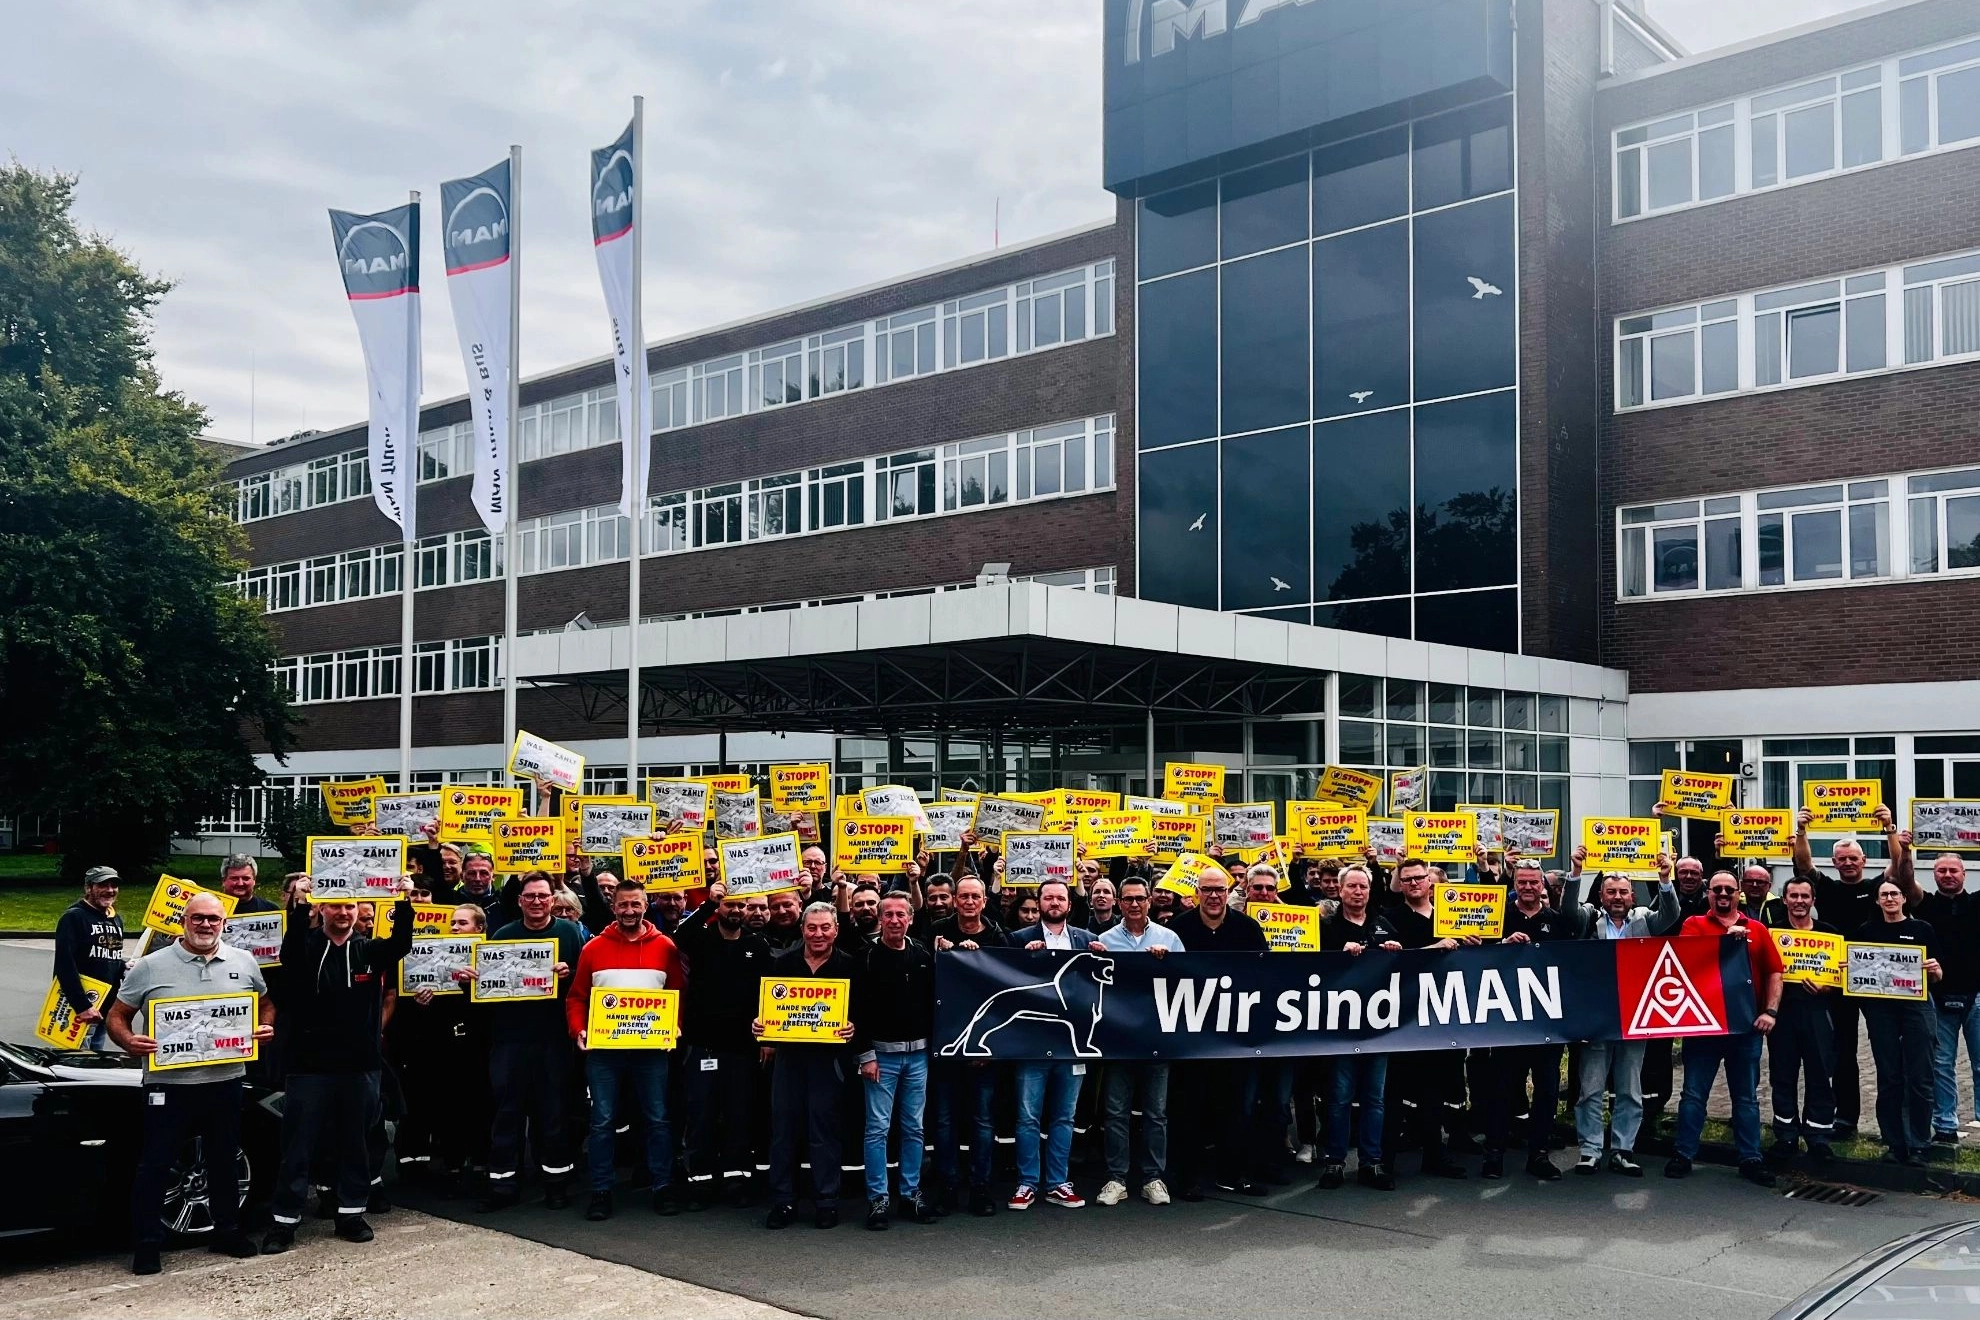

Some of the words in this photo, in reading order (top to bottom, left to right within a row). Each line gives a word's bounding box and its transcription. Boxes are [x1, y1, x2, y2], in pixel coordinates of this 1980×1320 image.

[1184, 769, 1217, 780] STOPP!
[1741, 763, 1754, 776] C
[785, 770, 821, 781] STOPP!
[1341, 773, 1374, 788] STOPP!
[1684, 778, 1723, 791] STOPP!
[340, 785, 377, 798] STOPP!
[1828, 786, 1871, 797] STOPP!
[467, 794, 512, 807] STOPP!
[871, 795, 890, 806] WAS
[1075, 796, 1112, 808] STOPP!
[382, 803, 402, 811] WAS
[985, 803, 1003, 813] WAS
[1015, 808, 1041, 819] ZÄHLT
[1919, 807, 1940, 816] WAS
[588, 811, 608, 820] WAS
[621, 811, 649, 821] ZÄHLT
[927, 811, 945, 819] WAS
[1218, 811, 1236, 819] WAS
[1247, 810, 1270, 819] ZÄHLT
[1319, 814, 1357, 826] STOPP!
[1102, 816, 1142, 826] STOPP!
[1428, 819, 1467, 830] STOPP!
[1530, 817, 1552, 827] ZÄHLT
[1744, 815, 1783, 826] STOPP!
[382, 827, 404, 835] SIND
[511, 825, 555, 837] STOPP!
[859, 824, 904, 836] STOPP!
[978, 826, 999, 837] SIND
[1158, 821, 1197, 833] STOPP!
[1382, 825, 1404, 834] ZÄHLT
[1608, 825, 1650, 837] STOPP!
[586, 836, 609, 845] SIND
[927, 834, 947, 843] SIND
[1217, 832, 1237, 842] SIND
[1249, 831, 1269, 840] WIR!
[1918, 831, 1942, 840] SIND
[648, 841, 693, 855] STOPP!
[1012, 841, 1032, 850] WAS
[1044, 840, 1071, 851] ZÄHLT
[1530, 839, 1549, 848] WIR!
[320, 847, 345, 858] WAS
[363, 845, 397, 858] ZÄHLT
[729, 849, 750, 859] WAS
[763, 843, 793, 856] ZÄHLT
[1010, 866, 1033, 876] SIND
[1046, 866, 1069, 875] WIR!
[317, 878, 346, 888] SIND
[366, 877, 394, 887] WIR!
[731, 875, 755, 886] SIND
[769, 869, 794, 881] WIR!
[1459, 892, 1498, 903] STOPP!
[416, 912, 448, 923] TOPP!
[1271, 912, 1310, 925] STOPP!
[249, 921, 279, 932] ZÄHLT
[1794, 937, 1835, 951] STOPP!
[252, 946, 277, 957] WIR!
[483, 951, 505, 961] WAS
[520, 948, 551, 960] ZÄHLT
[1854, 951, 1875, 961] WAS
[1889, 952, 1919, 964] ZÄHLT
[409, 973, 435, 983] SIND
[480, 979, 506, 989] SIND
[521, 976, 547, 987] WIR!
[1853, 976, 1877, 986] SIND
[1893, 977, 1916, 988] WIR!
[789, 987, 837, 999] STOPP!
[620, 997, 667, 1009] STOPP!
[1153, 975, 1261, 1033] Wir
[1274, 972, 1401, 1032] sind
[1417, 966, 1564, 1027] MAN
[776, 1003, 799, 1011] HÄNDE
[164, 1009, 192, 1022] WAS
[211, 1005, 249, 1018] ZÄHLT
[162, 1042, 194, 1054] SIND
[215, 1036, 245, 1049] WIR!
